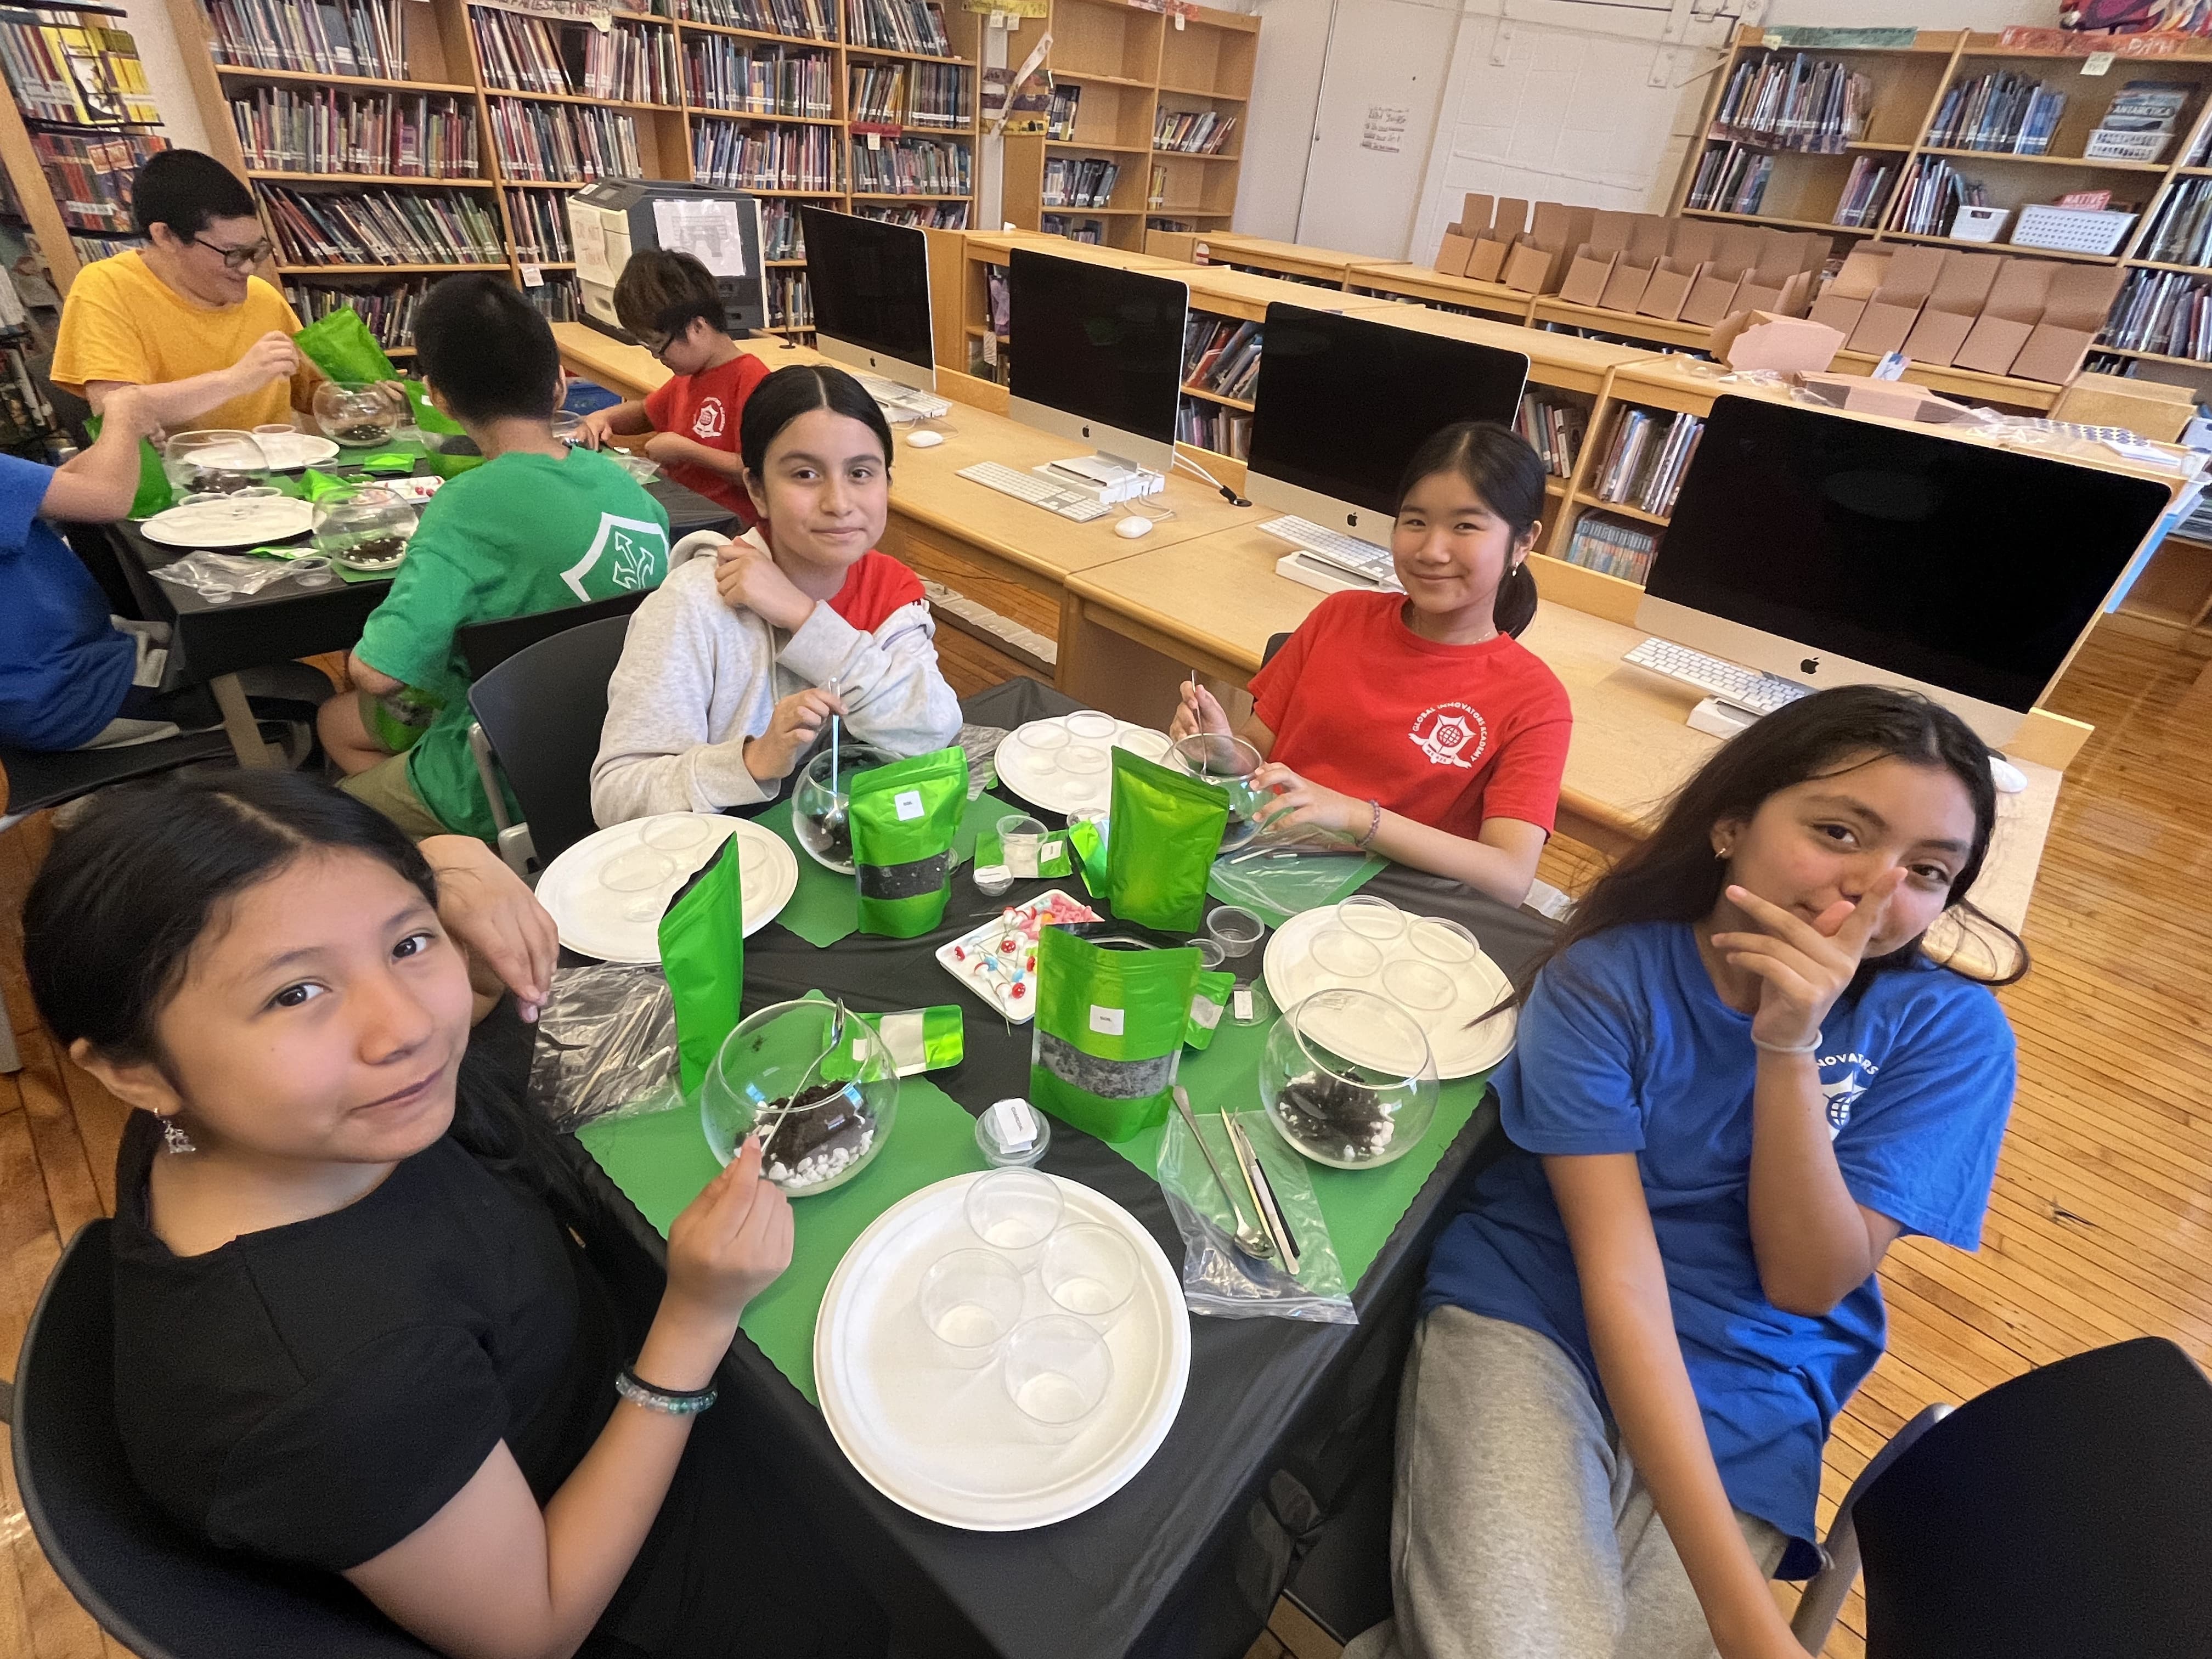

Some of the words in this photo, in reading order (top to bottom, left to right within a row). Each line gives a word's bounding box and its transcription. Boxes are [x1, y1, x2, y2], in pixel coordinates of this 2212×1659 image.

[1412, 707, 1436, 732] GLOBAL
[1437, 702, 1486, 726] INNOVATORS
[1471, 727, 1488, 761] ACADEMY
